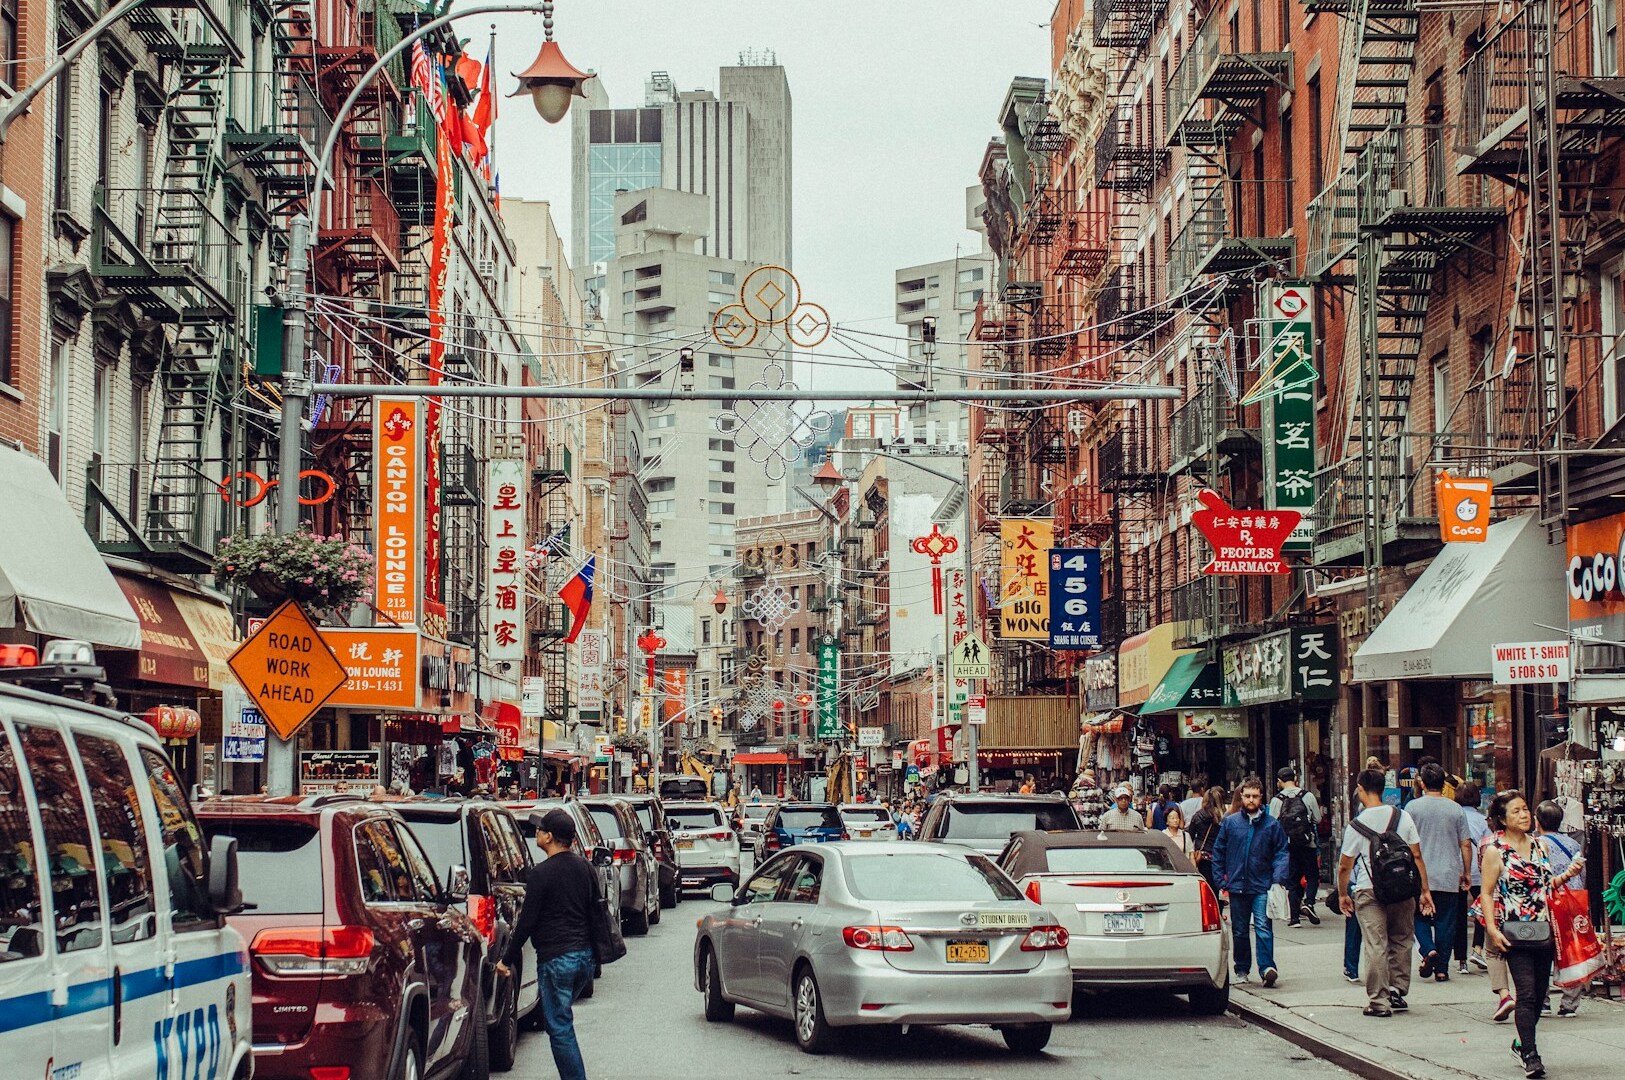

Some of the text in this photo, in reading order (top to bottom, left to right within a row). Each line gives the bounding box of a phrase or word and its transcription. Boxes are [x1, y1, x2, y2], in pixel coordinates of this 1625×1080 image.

[385, 445, 407, 593] CANTON LOUNGE
[1212, 516, 1280, 529] 仁安西藥房
[1220, 547, 1274, 559] PEOPLES
[493, 481, 521, 647] 皇上皇酒家
[1213, 561, 1281, 573] PHARMACY
[386, 598, 406, 608] 212
[1014, 600, 1041, 615] BIG
[1005, 618, 1050, 632] WONG
[268, 632, 312, 652] ROAD
[1497, 647, 1527, 661] WHITE
[1541, 646, 1569, 659] SHIRT
[266, 657, 311, 678] WORK
[363, 667, 401, 677] LOUNGE
[957, 666, 986, 675] AHEAD
[1509, 666, 1516, 679] 5
[1518, 665, 1536, 678] FOR
[1547, 665, 1558, 677] 10
[259, 682, 314, 704] AHEAD
[980, 914, 1006, 924] STUDENT
[1008, 914, 1028, 924] DRIVER
[273, 1005, 308, 1013] LIMITED
[154, 1003, 220, 1080] NYPD
